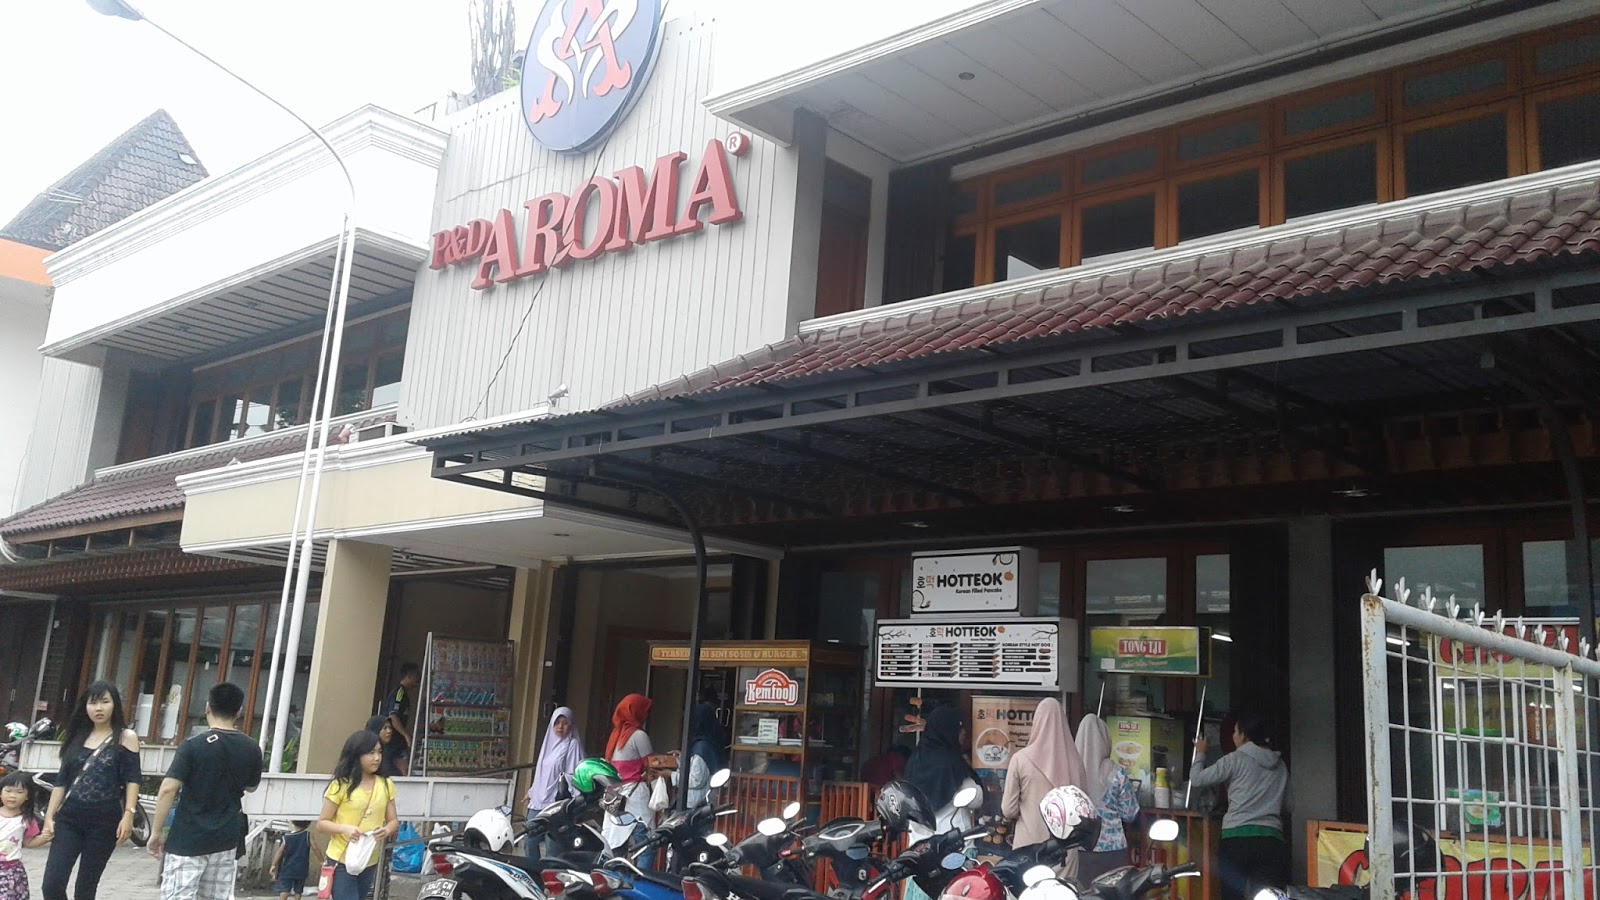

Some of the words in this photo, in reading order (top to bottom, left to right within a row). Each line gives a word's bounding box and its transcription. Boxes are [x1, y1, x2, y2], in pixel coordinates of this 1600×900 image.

[429, 217, 493, 270] P&D
[471, 139, 743, 291] AROMA
[936, 572, 1003, 588] HOTTEOK
[945, 626, 997, 638] HOTTEOK
[1122, 640, 1146, 654] TONG
[1148, 640, 1162, 655] TJI
[996, 709, 1034, 721] HOTT
